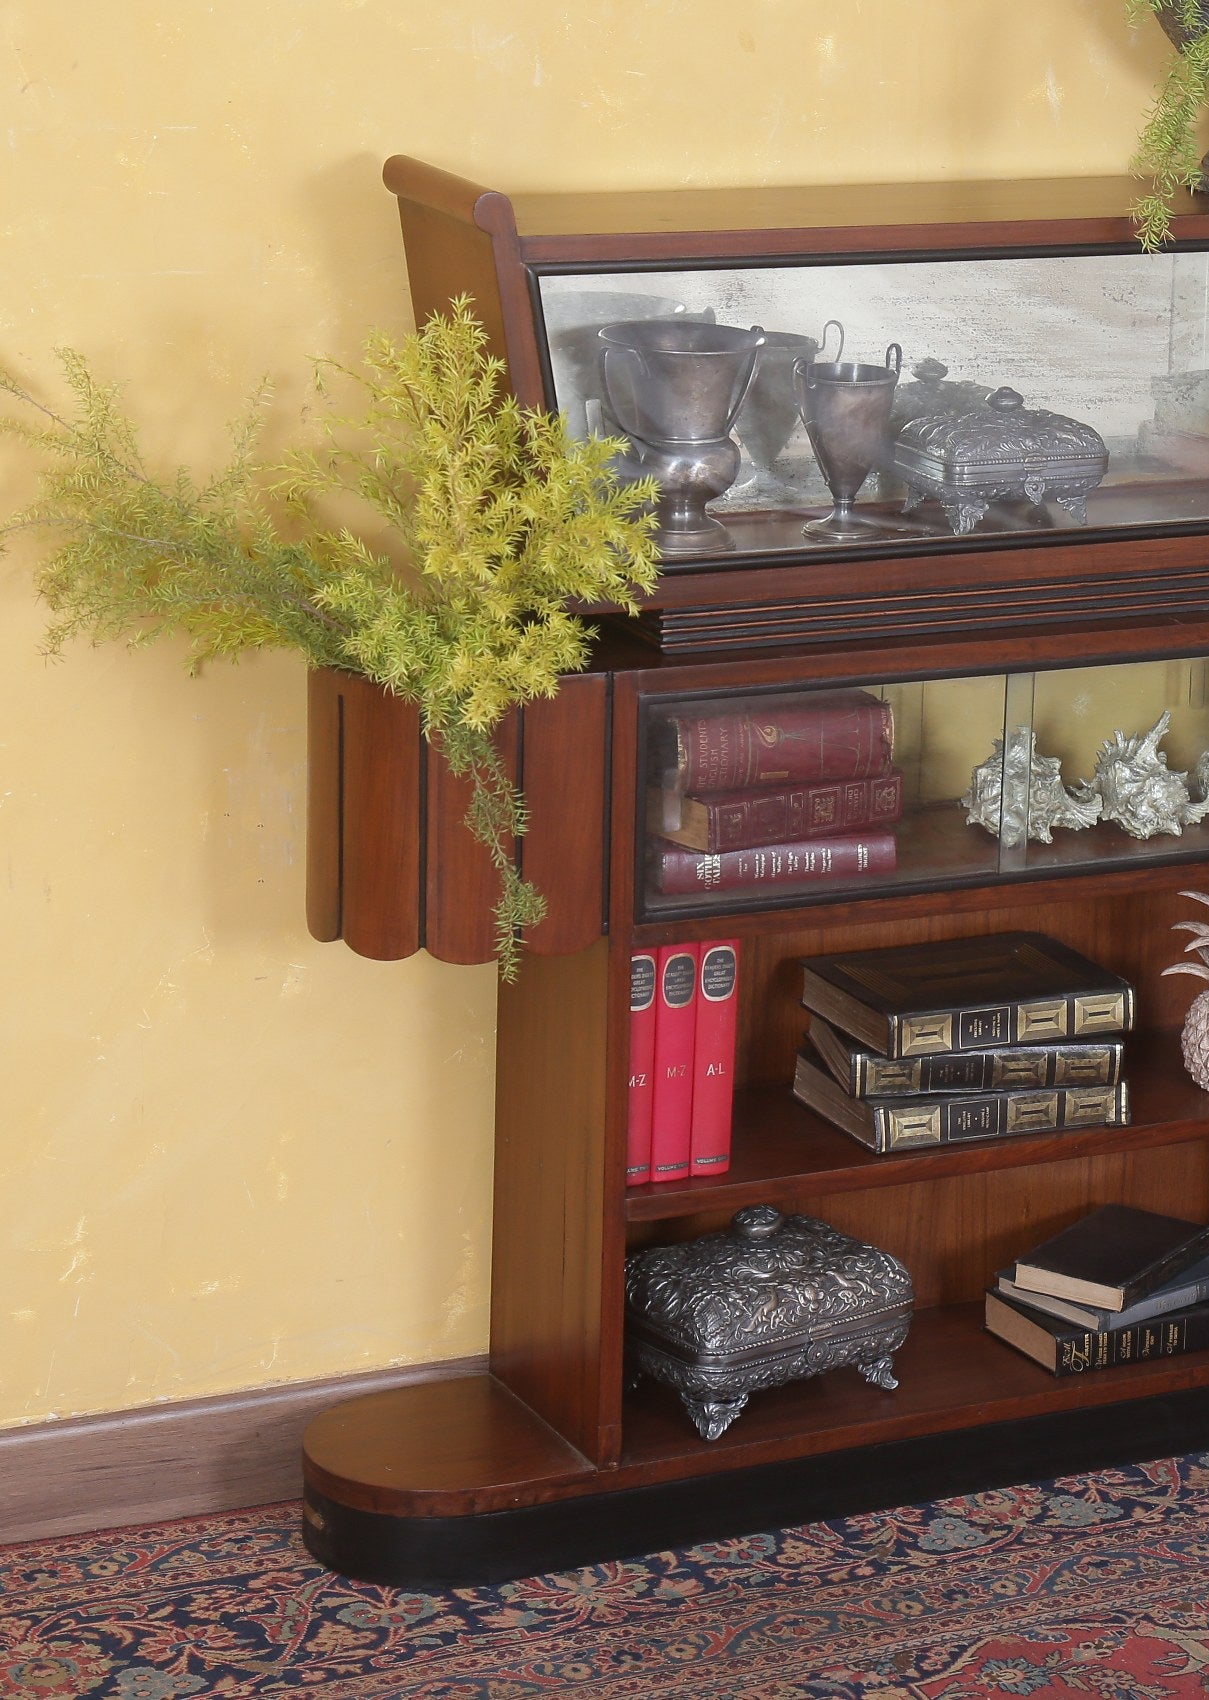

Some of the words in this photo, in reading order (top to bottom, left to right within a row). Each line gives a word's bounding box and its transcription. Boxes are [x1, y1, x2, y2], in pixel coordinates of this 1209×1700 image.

[696, 862, 704, 880] SIX
[704, 853, 713, 890] GOTHI
[712, 854, 721, 884] TALES
[666, 1064, 687, 1078] M-Z
[706, 1062, 726, 1076] A-L
[628, 1073, 646, 1088] M-Z
